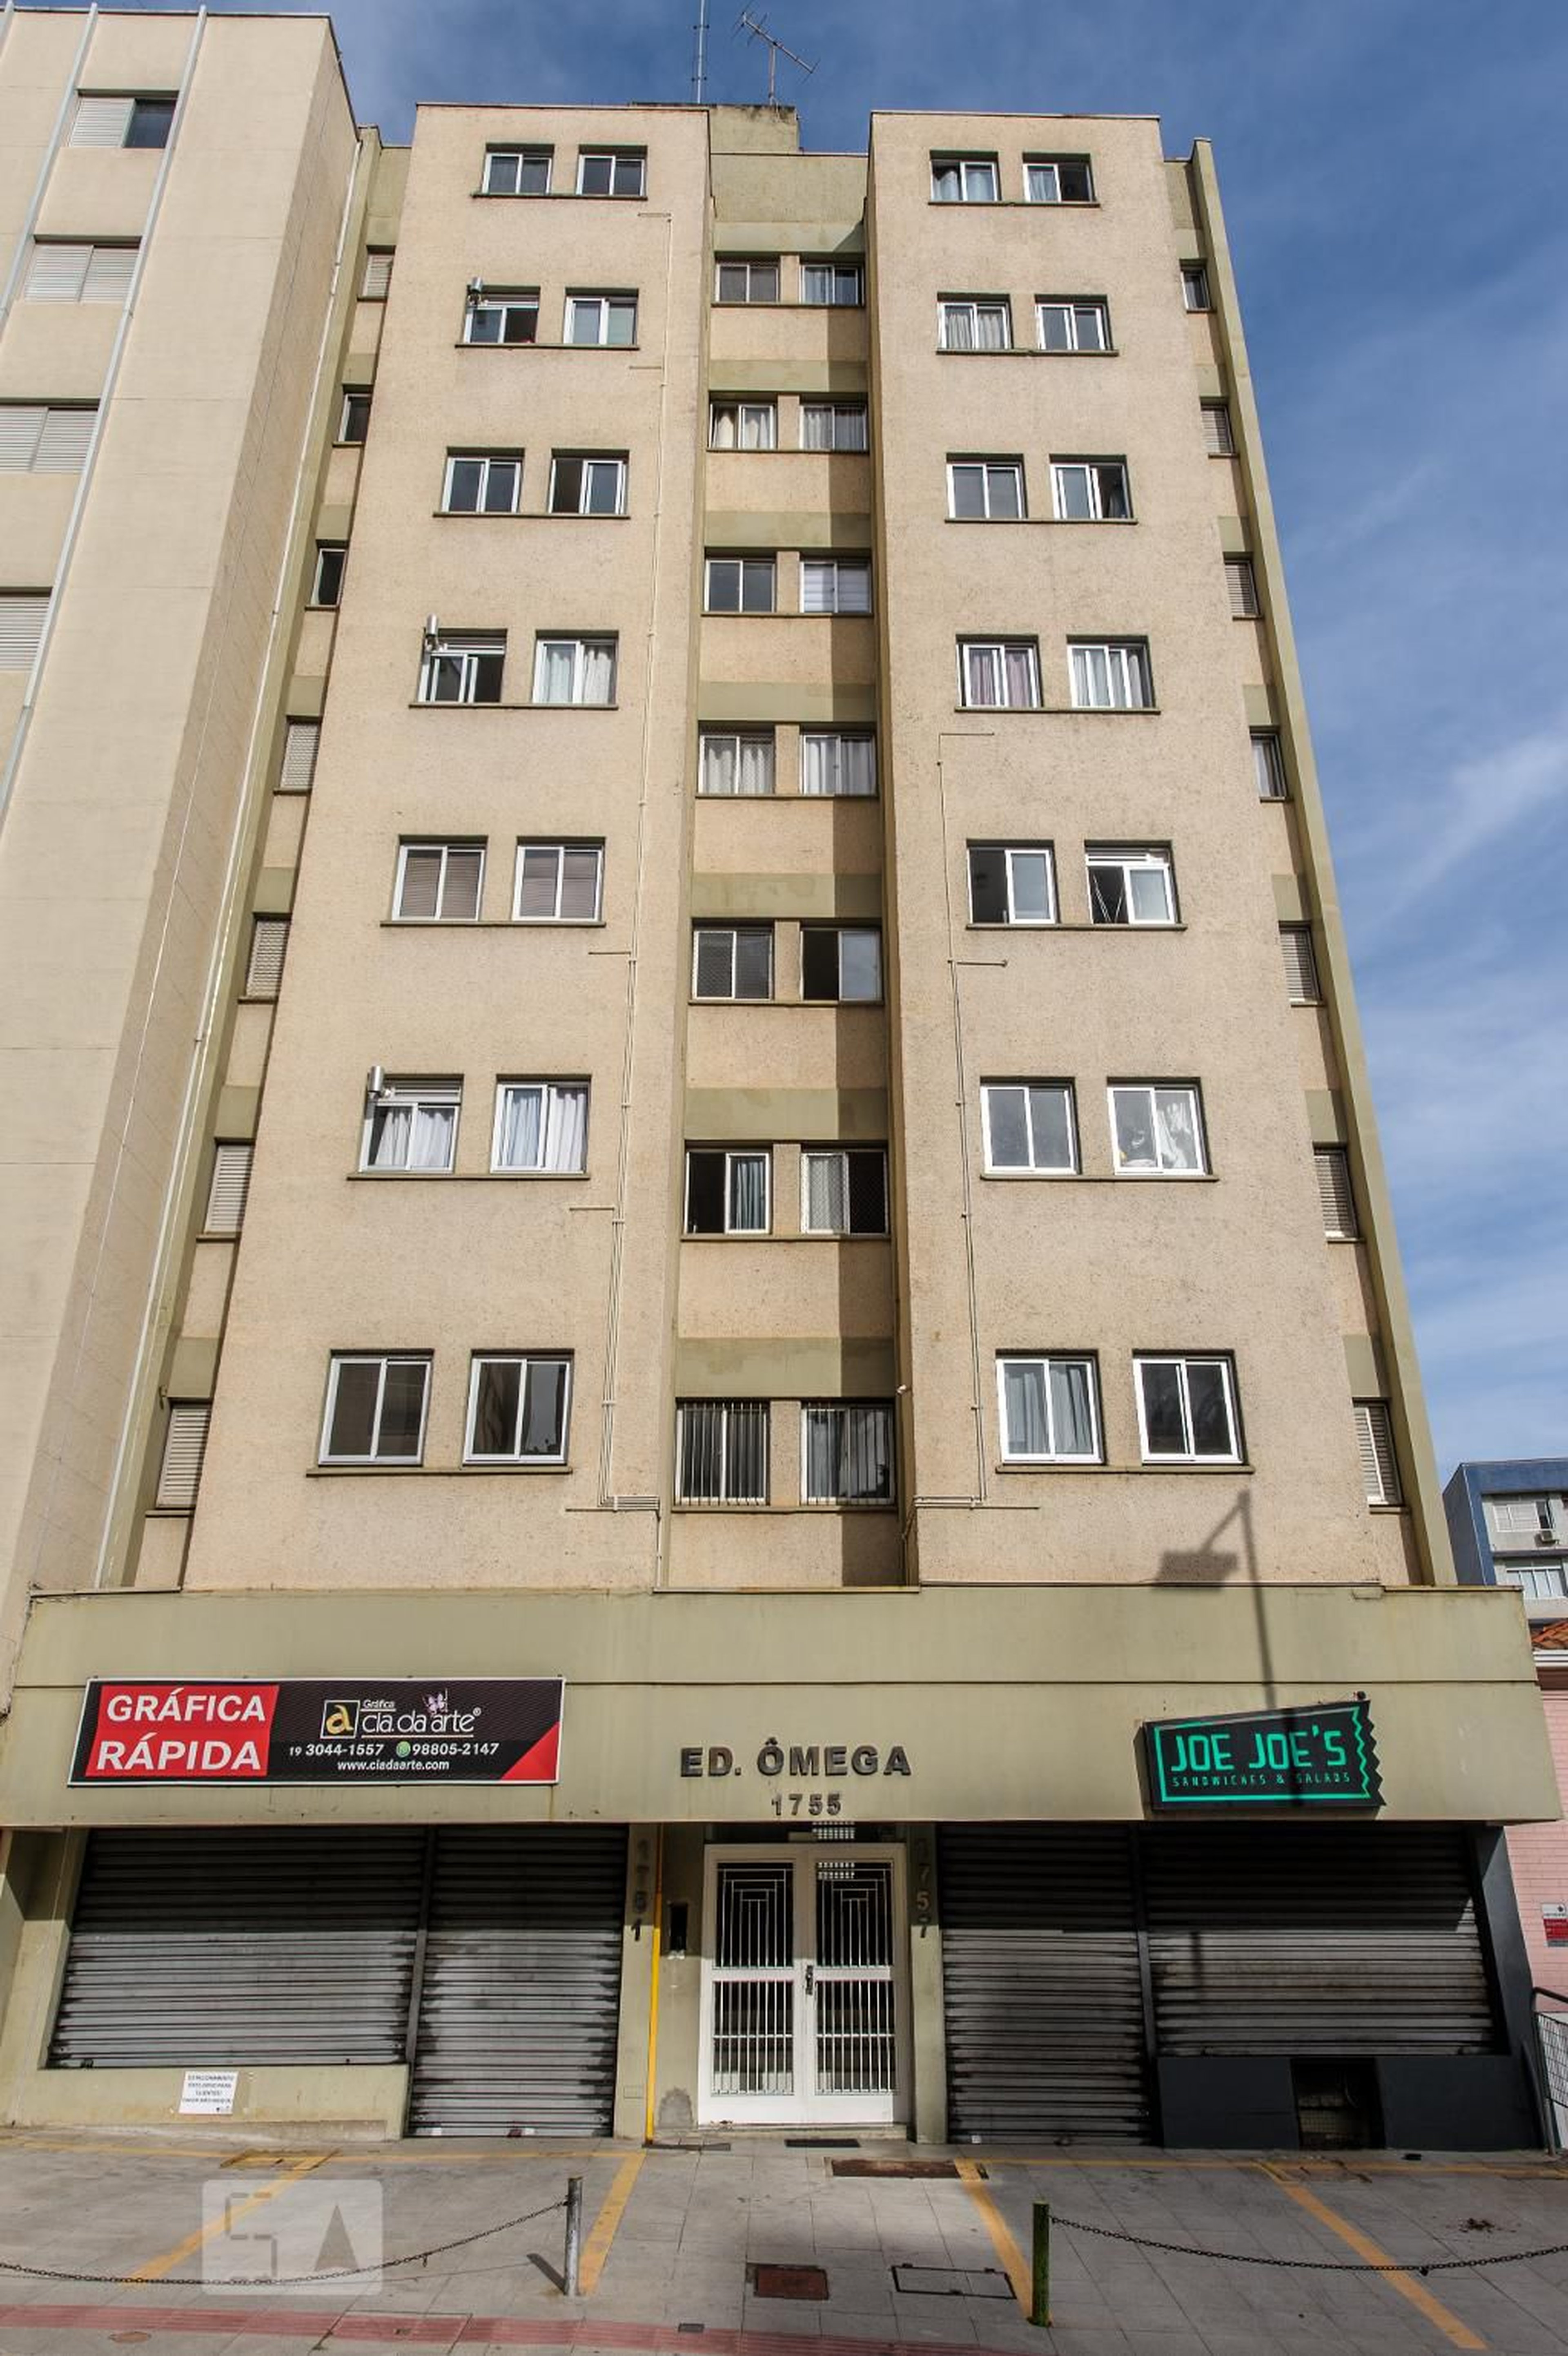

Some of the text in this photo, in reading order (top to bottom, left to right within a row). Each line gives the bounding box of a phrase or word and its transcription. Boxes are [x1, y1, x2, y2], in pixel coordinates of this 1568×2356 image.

[107, 1687, 265, 1722] GRÁFICA
[397, 1710, 427, 1733] da
[97, 1732, 261, 1770] RÁPIDA
[289, 1743, 499, 1756] 19 3044-1557 98805-2147
[680, 1737, 911, 1777] ED. ÔMEGA
[1171, 1725, 1347, 1771] JOE JOE'S
[337, 1759, 450, 1771] www.ciadaarte.com
[1276, 1774, 1285, 1784] &
[771, 1794, 841, 1816] 1755
